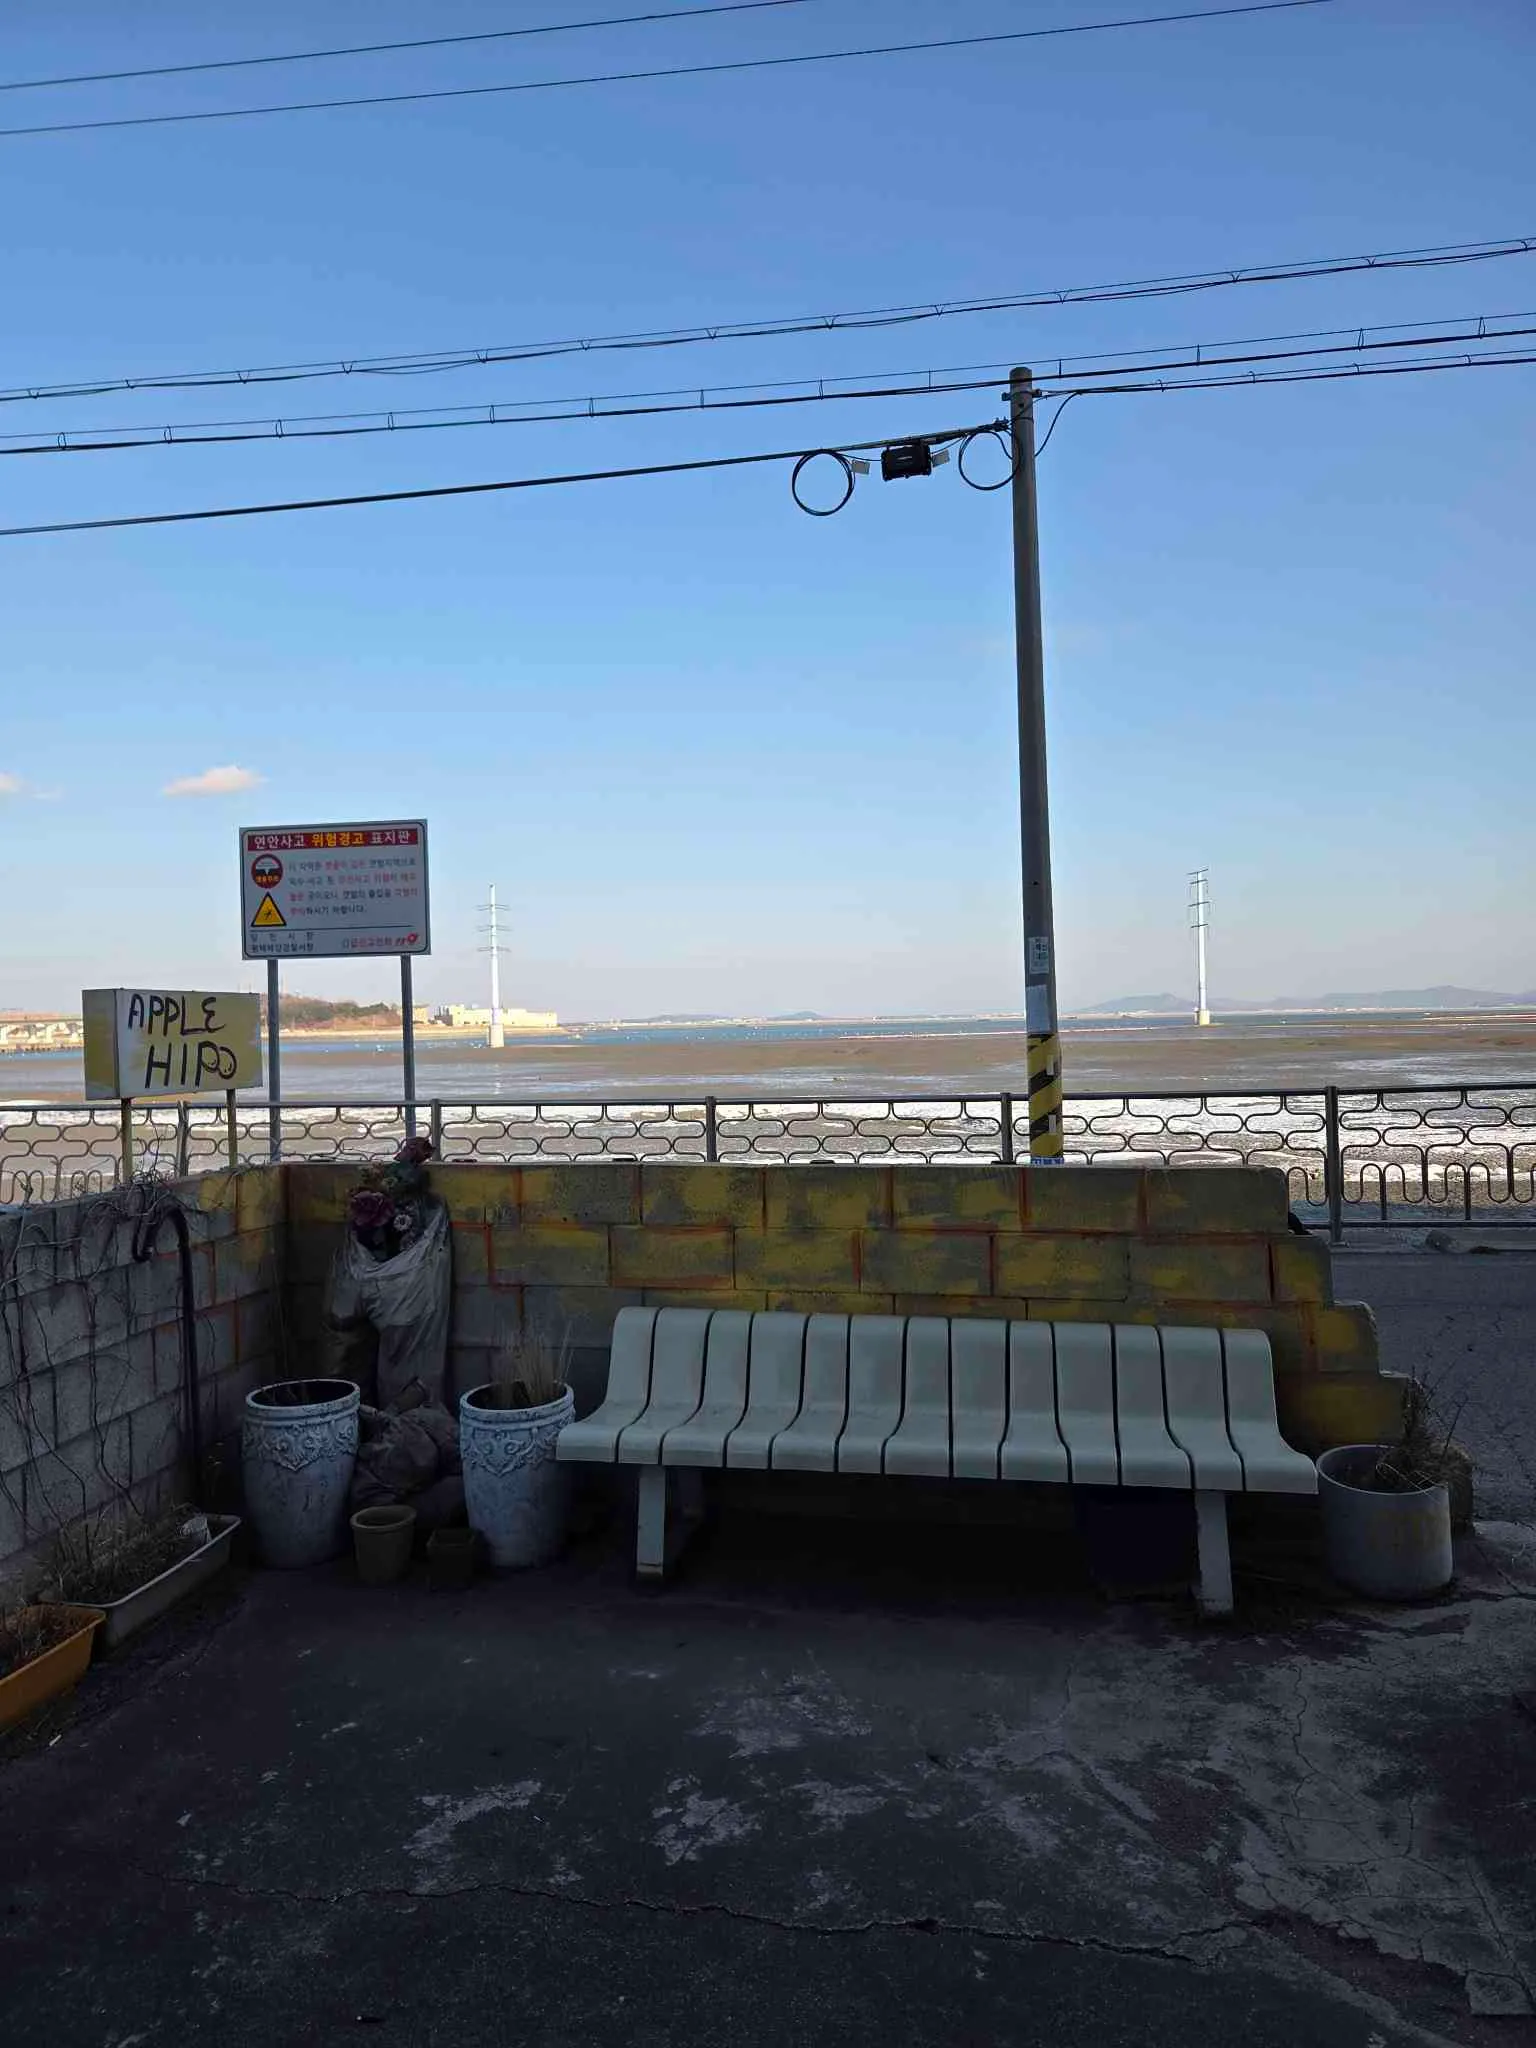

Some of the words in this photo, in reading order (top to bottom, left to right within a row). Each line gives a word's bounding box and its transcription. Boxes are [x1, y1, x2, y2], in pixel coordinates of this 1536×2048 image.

[254, 834, 305, 850] 연안사고
[312, 832, 365, 848] 위험경고
[370, 830, 410, 845] 표지판
[127, 993, 225, 1037] APPLE
